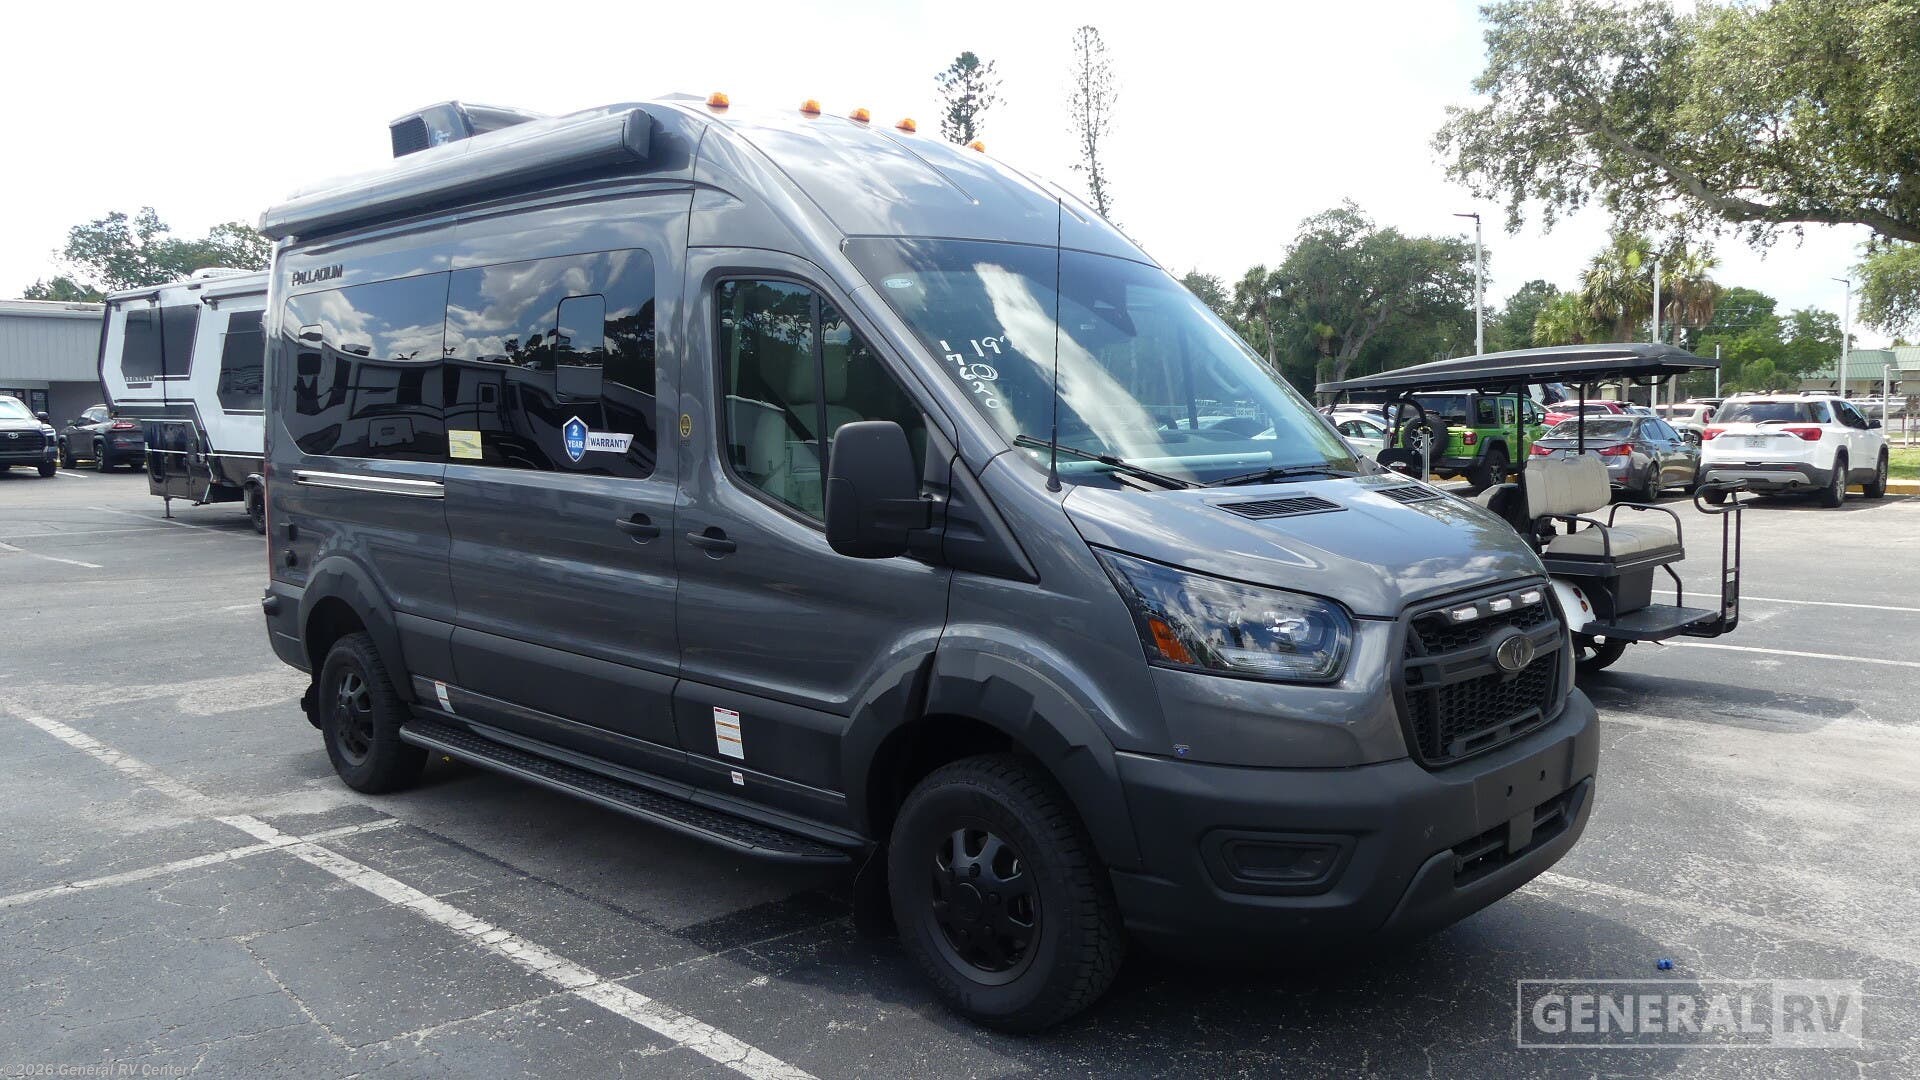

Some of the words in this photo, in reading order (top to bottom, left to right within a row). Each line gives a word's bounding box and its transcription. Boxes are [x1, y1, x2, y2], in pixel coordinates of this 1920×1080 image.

[292, 264, 343, 286] PALLADIUM
[572, 424, 579, 437] 2
[567, 440, 583, 449] YEAR
[590, 437, 628, 449] WARRANTY
